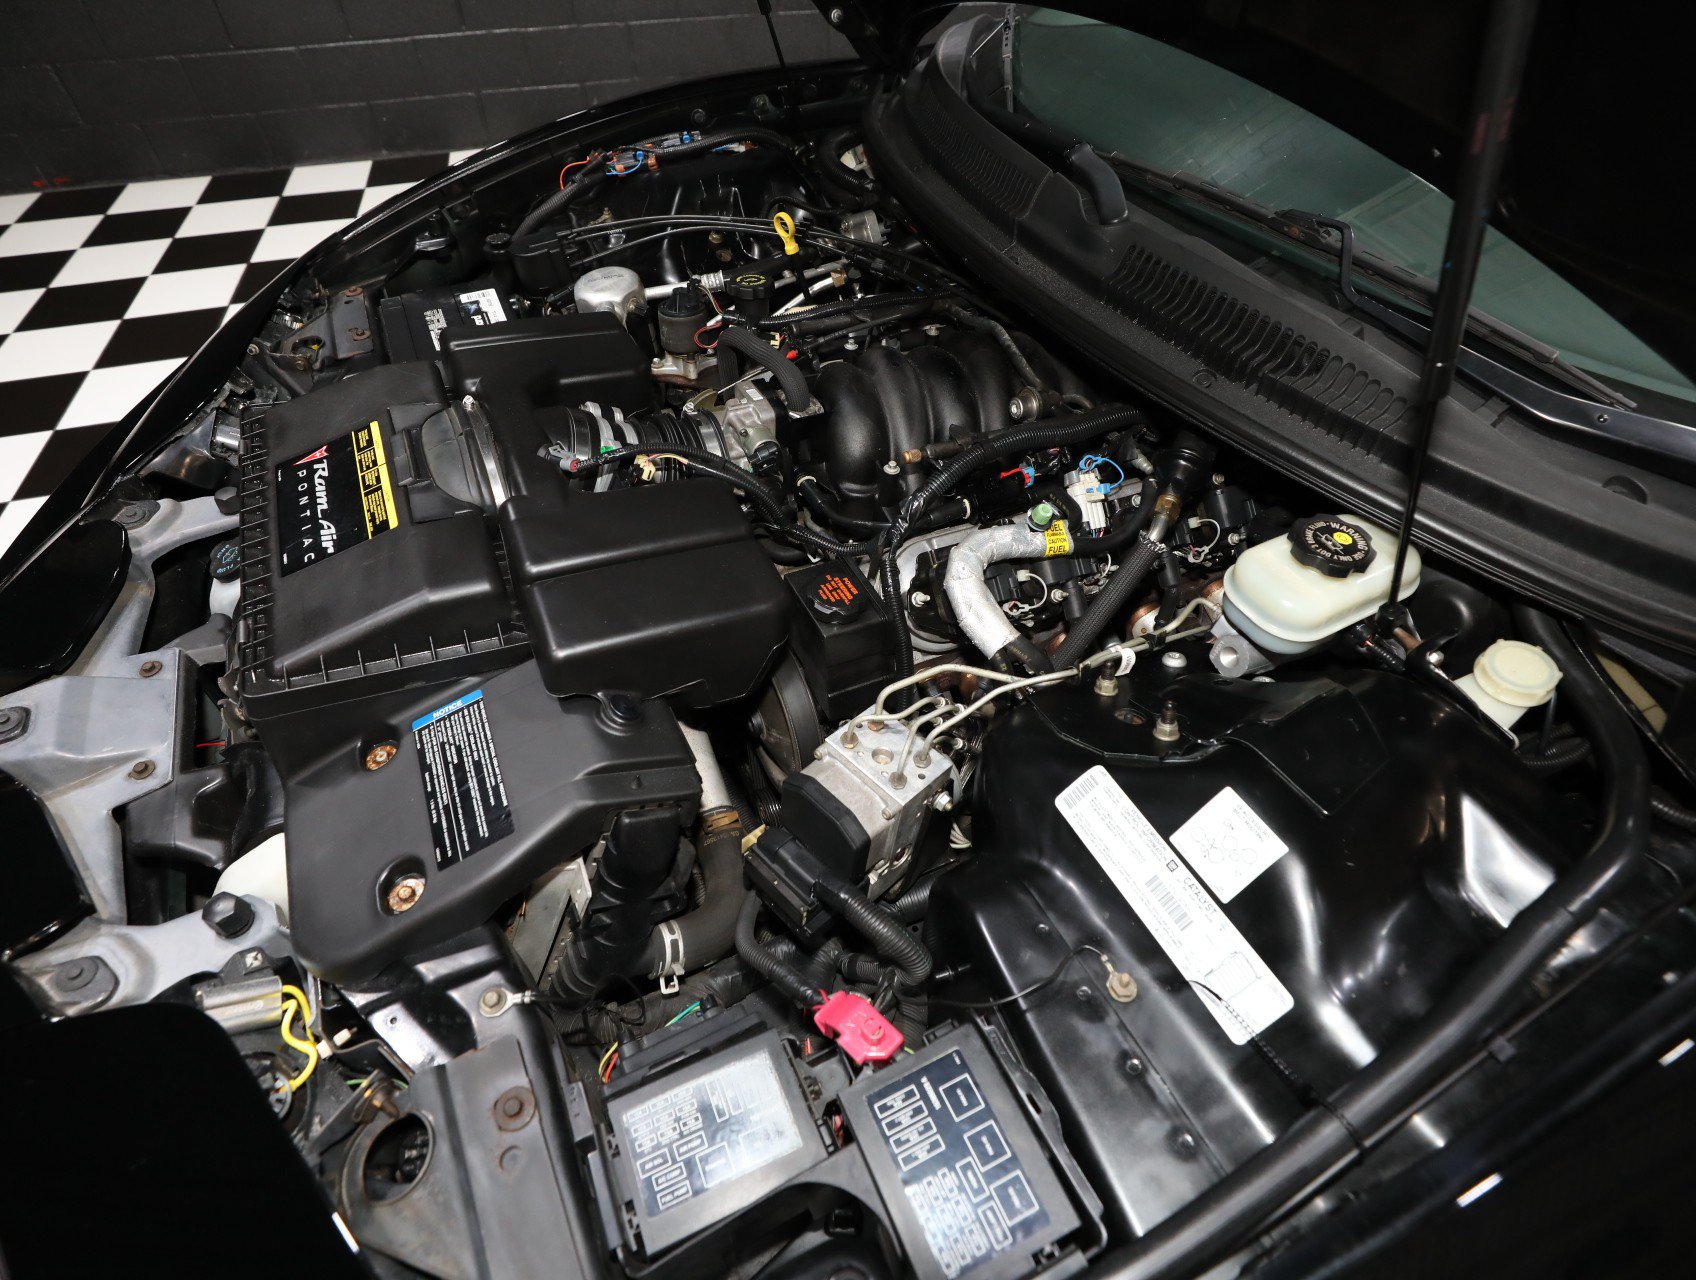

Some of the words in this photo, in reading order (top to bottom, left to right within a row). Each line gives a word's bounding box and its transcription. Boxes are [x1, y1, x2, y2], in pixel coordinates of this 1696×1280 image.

[313, 459, 329, 518] Ram
[297, 469, 315, 563] PONTIAC
[1047, 524, 1062, 532] UEL
[1309, 522, 1326, 530] FLUID
[319, 519, 337, 554] Air
[1305, 529, 1315, 544] BRAKE
[1329, 522, 1368, 551] WARNING
[1316, 548, 1331, 558] DOT
[1352, 552, 1366, 560] USE
[833, 577, 853, 600] STEERING
[843, 577, 859, 594] POWER
[433, 700, 462, 719] NOTICE
[1183, 876, 1217, 916] CATALYST
